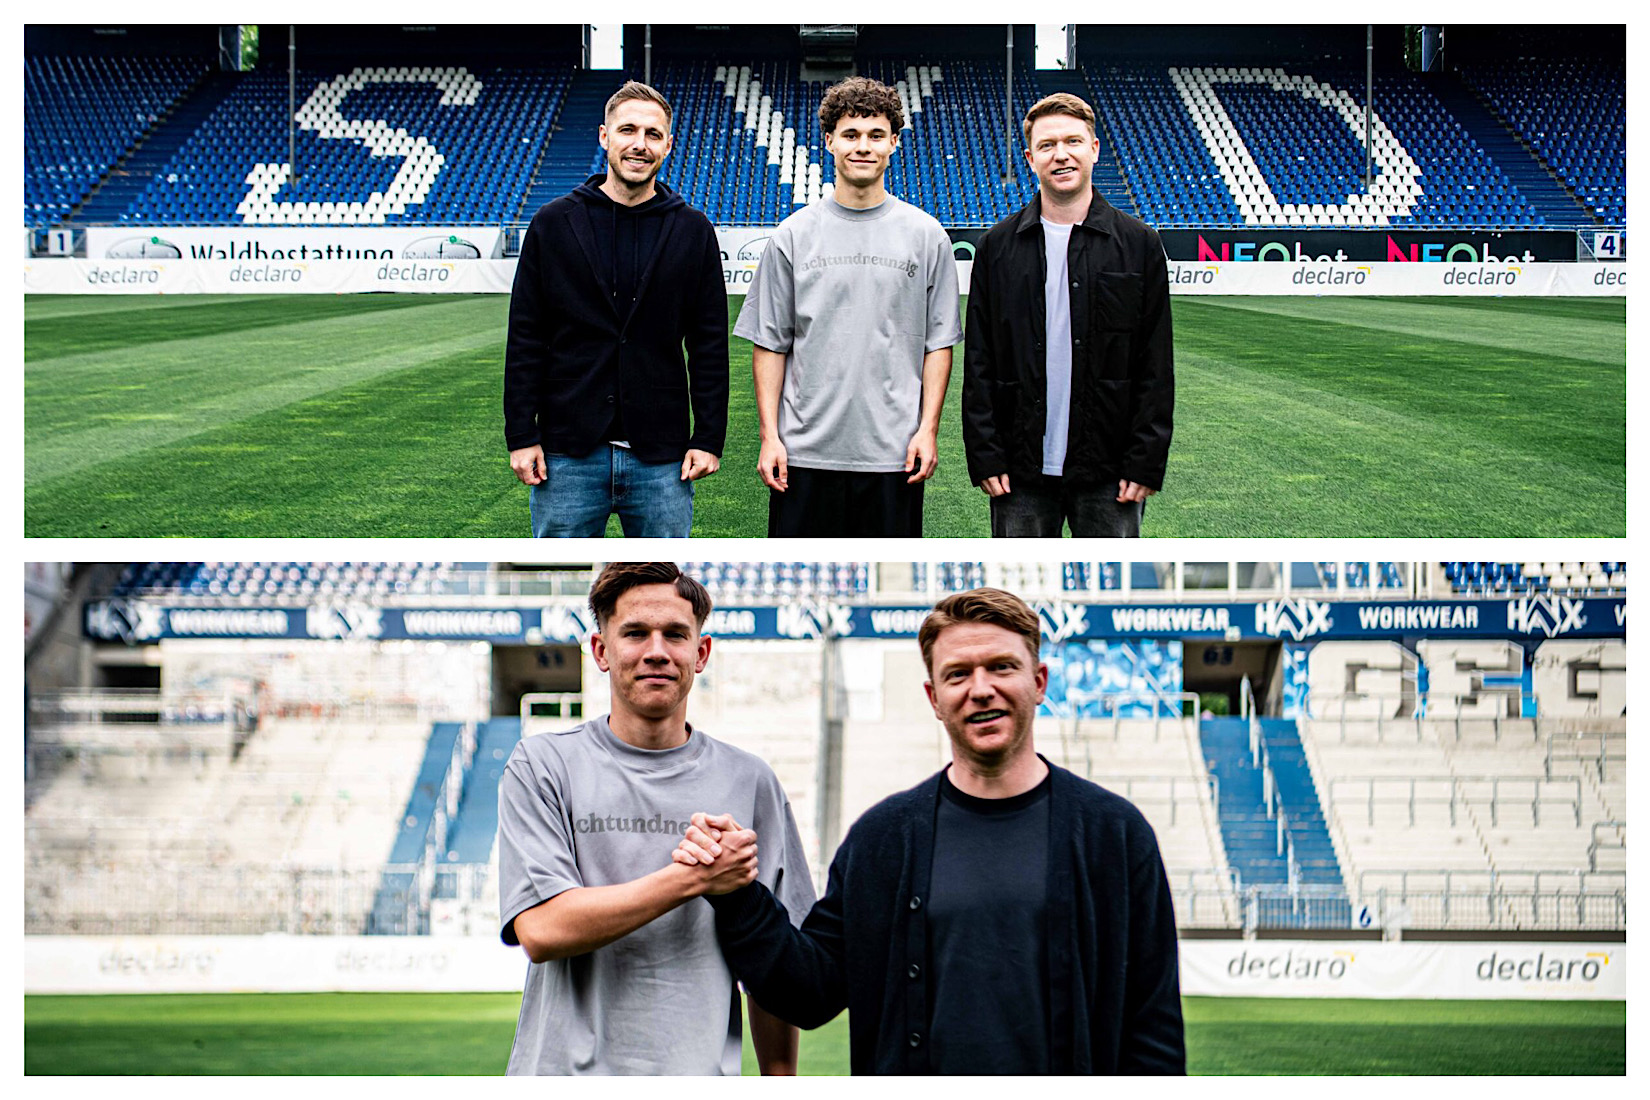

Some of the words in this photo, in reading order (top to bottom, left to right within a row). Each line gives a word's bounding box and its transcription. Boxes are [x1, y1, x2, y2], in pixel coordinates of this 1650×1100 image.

[57, 232, 65, 252] 1
[1601, 235, 1616, 255] 4
[87, 266, 159, 284] declaro
[229, 264, 302, 282] declaro
[377, 263, 449, 281] declaro
[801, 252, 919, 278] achtundneunzig
[1167, 265, 1214, 284] claro
[1292, 266, 1366, 285] declaro
[1443, 267, 1516, 285] declaro
[1112, 608, 1230, 632] WORKWEAR
[1359, 606, 1479, 629] WORKWEAR
[574, 812, 691, 836] chtundne
[1359, 905, 1371, 928] 6
[1227, 949, 1346, 979] declaro
[1476, 952, 1600, 981] declaro
